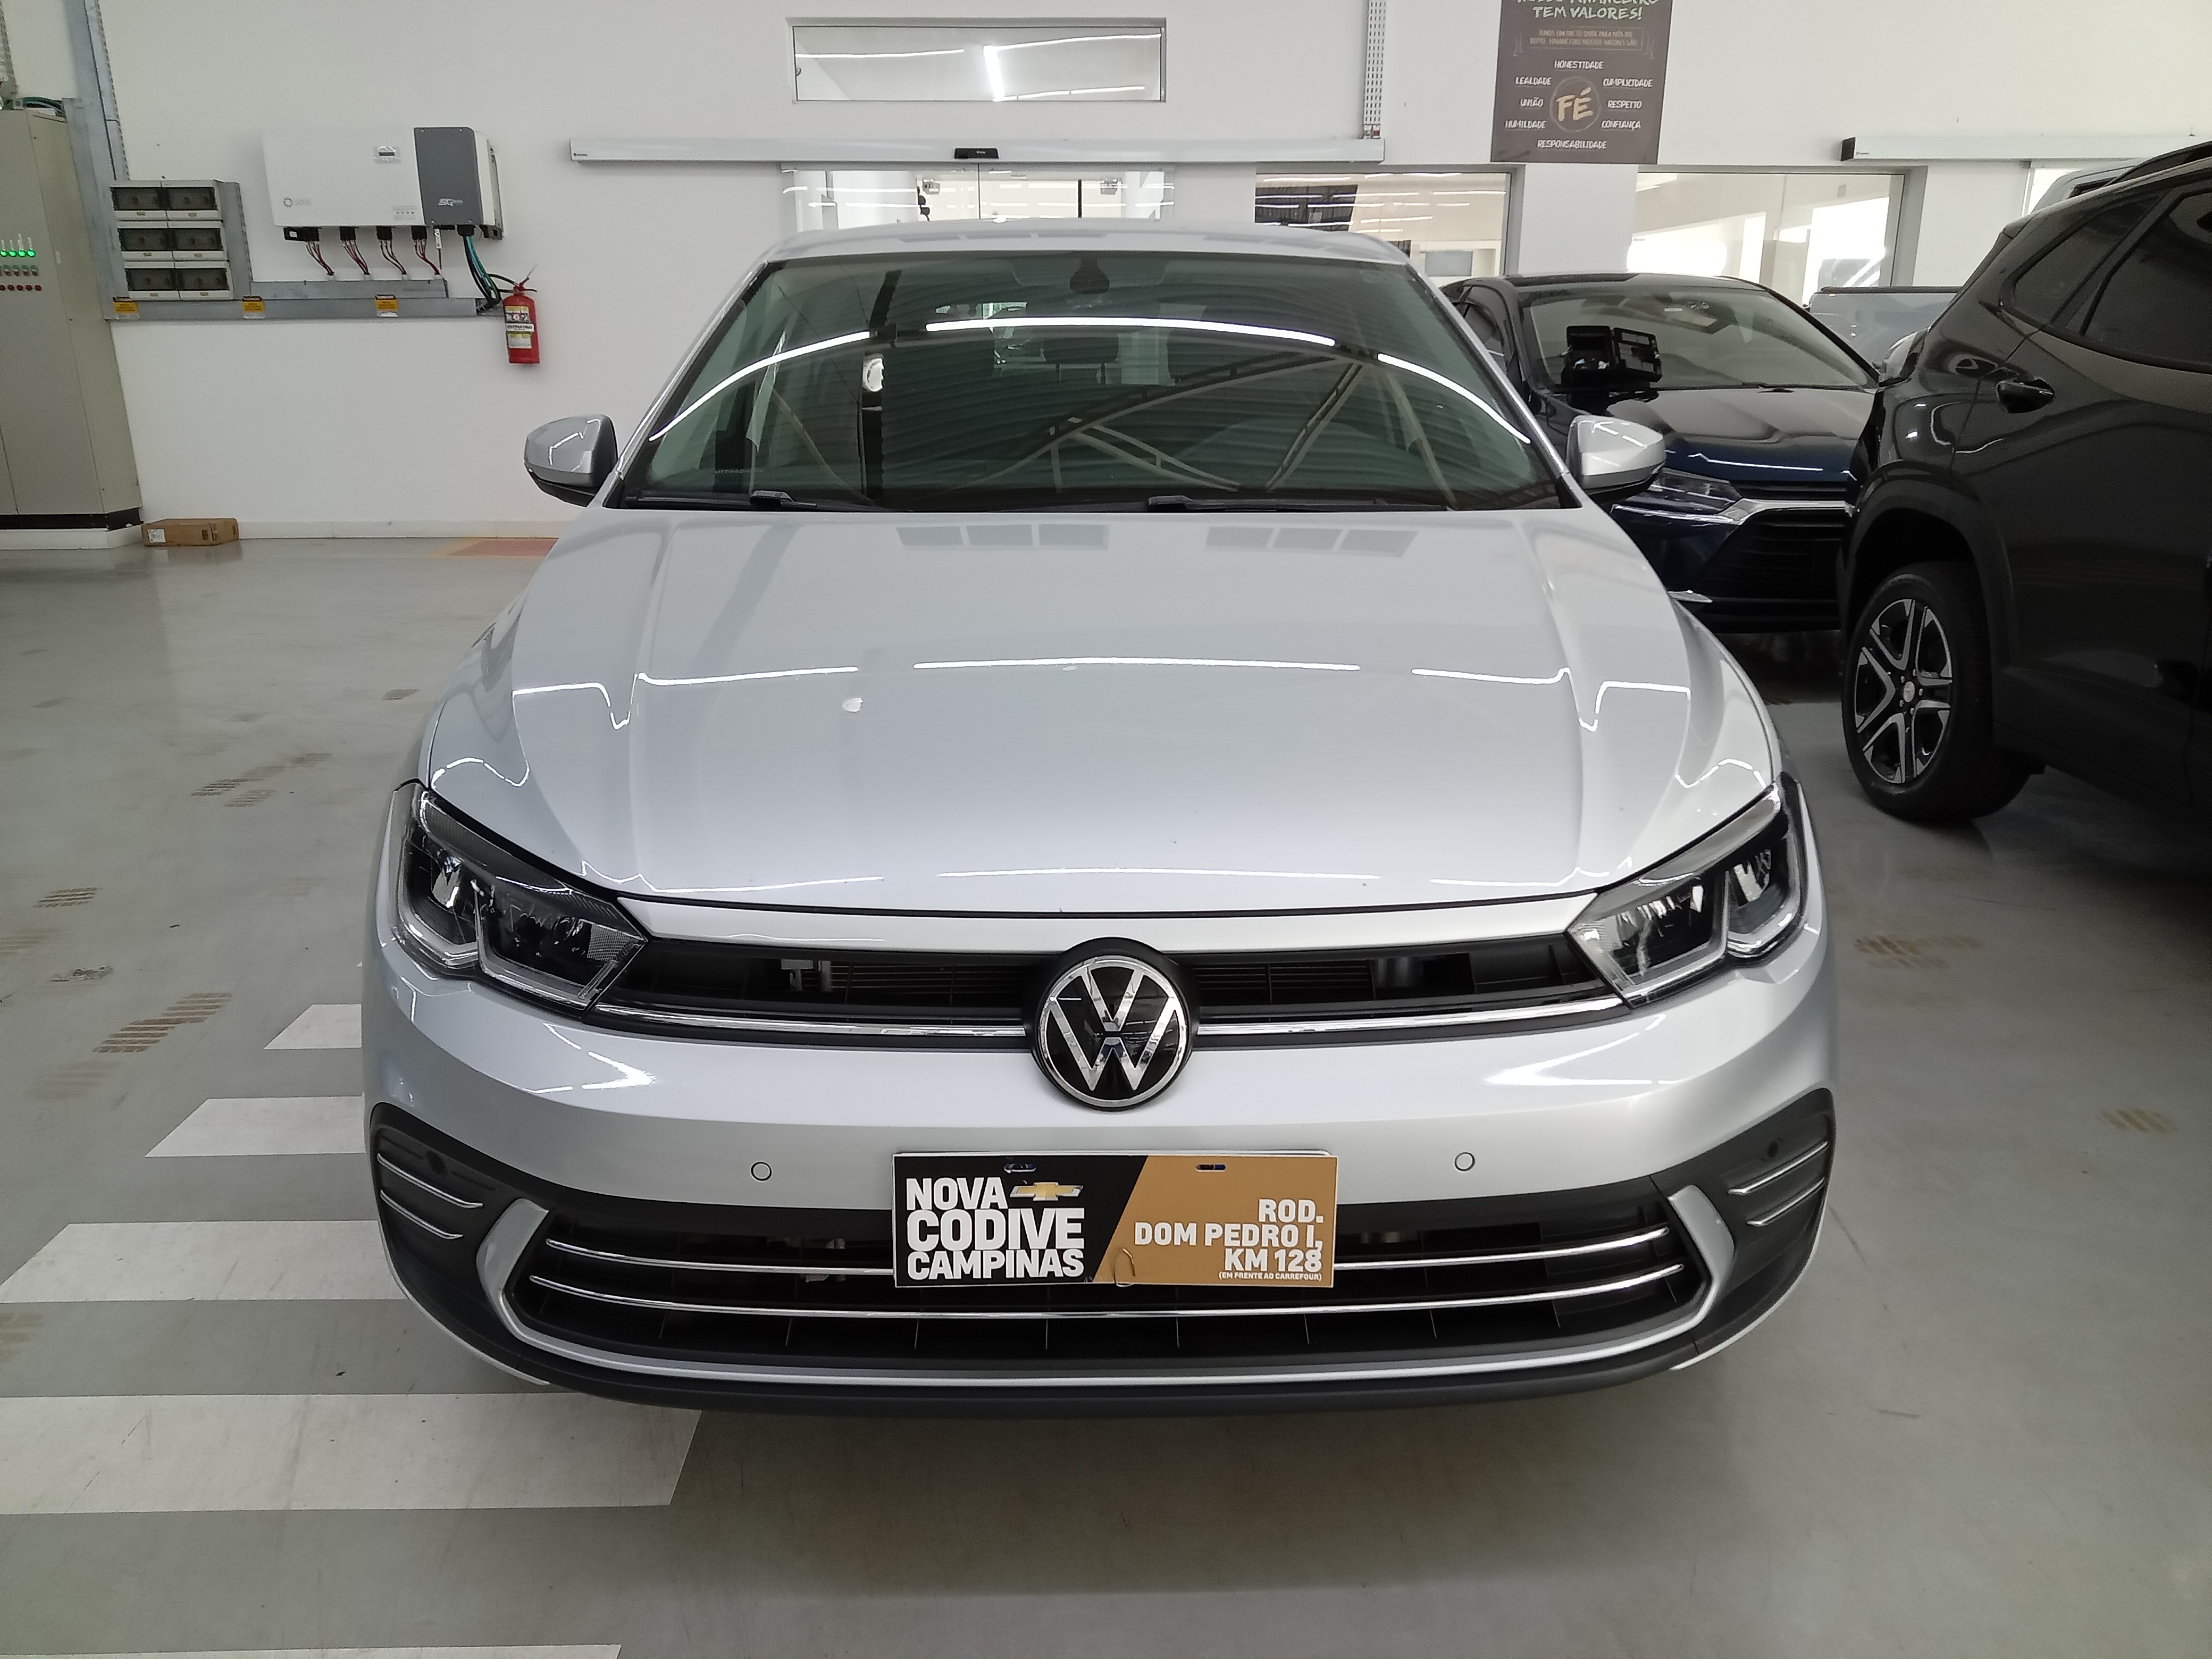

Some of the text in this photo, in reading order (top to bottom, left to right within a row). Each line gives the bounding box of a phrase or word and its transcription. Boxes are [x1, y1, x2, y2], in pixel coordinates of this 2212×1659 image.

[1532, 6, 1643, 20] TEM VALORES!
[1554, 60, 1604, 70] HONESTIDADE
[1515, 77, 1552, 86] LEALDADE
[1603, 78, 1653, 88] CUMPLICIDADE
[1520, 97, 1544, 107] UNIÃO
[1556, 86, 1594, 122] FÉ
[1607, 100, 1642, 109] RESPEITO
[1505, 120, 1546, 129] HUMILDADE
[1602, 120, 1641, 130] CONFIANÇA
[1537, 139, 1607, 149] RESPONSABILIDADE
[906, 1177, 1008, 1210] NOVA
[1259, 1199, 1324, 1223] ROD.
[907, 1208, 1085, 1251] CODIVE
[1135, 1222, 1323, 1251] DOM PEDRO I,
[907, 1249, 1084, 1280] CAMPINAS
[1225, 1249, 1322, 1272] KM 128
[1275, 1272, 1322, 1281] CARREFOUR)
